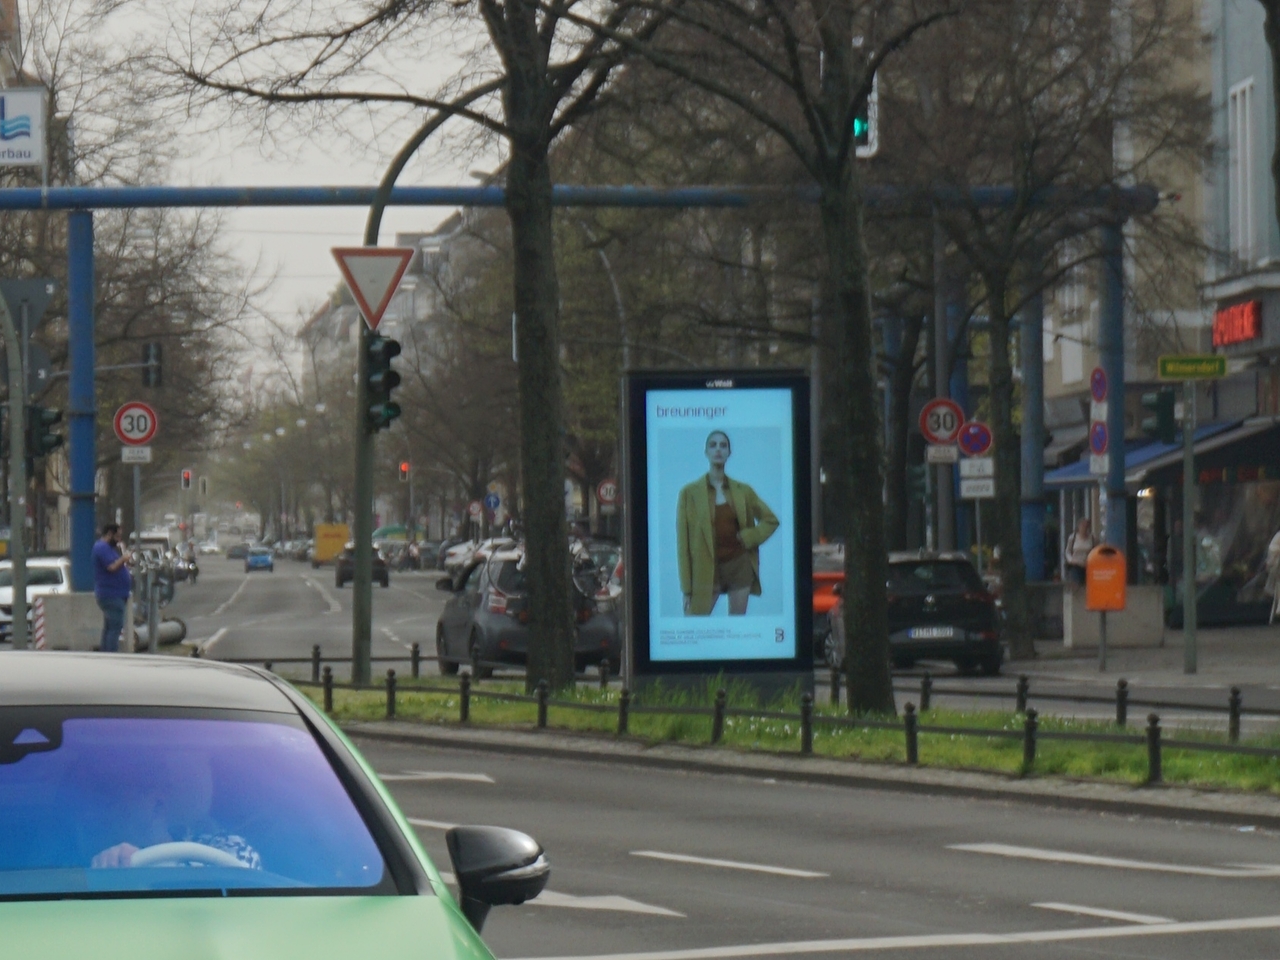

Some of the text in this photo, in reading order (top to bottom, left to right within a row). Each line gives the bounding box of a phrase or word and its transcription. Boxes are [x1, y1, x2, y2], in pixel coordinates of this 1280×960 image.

[656, 405, 727, 419] breuninger
[124, 415, 147, 433] 30
[929, 412, 954, 432] 30
